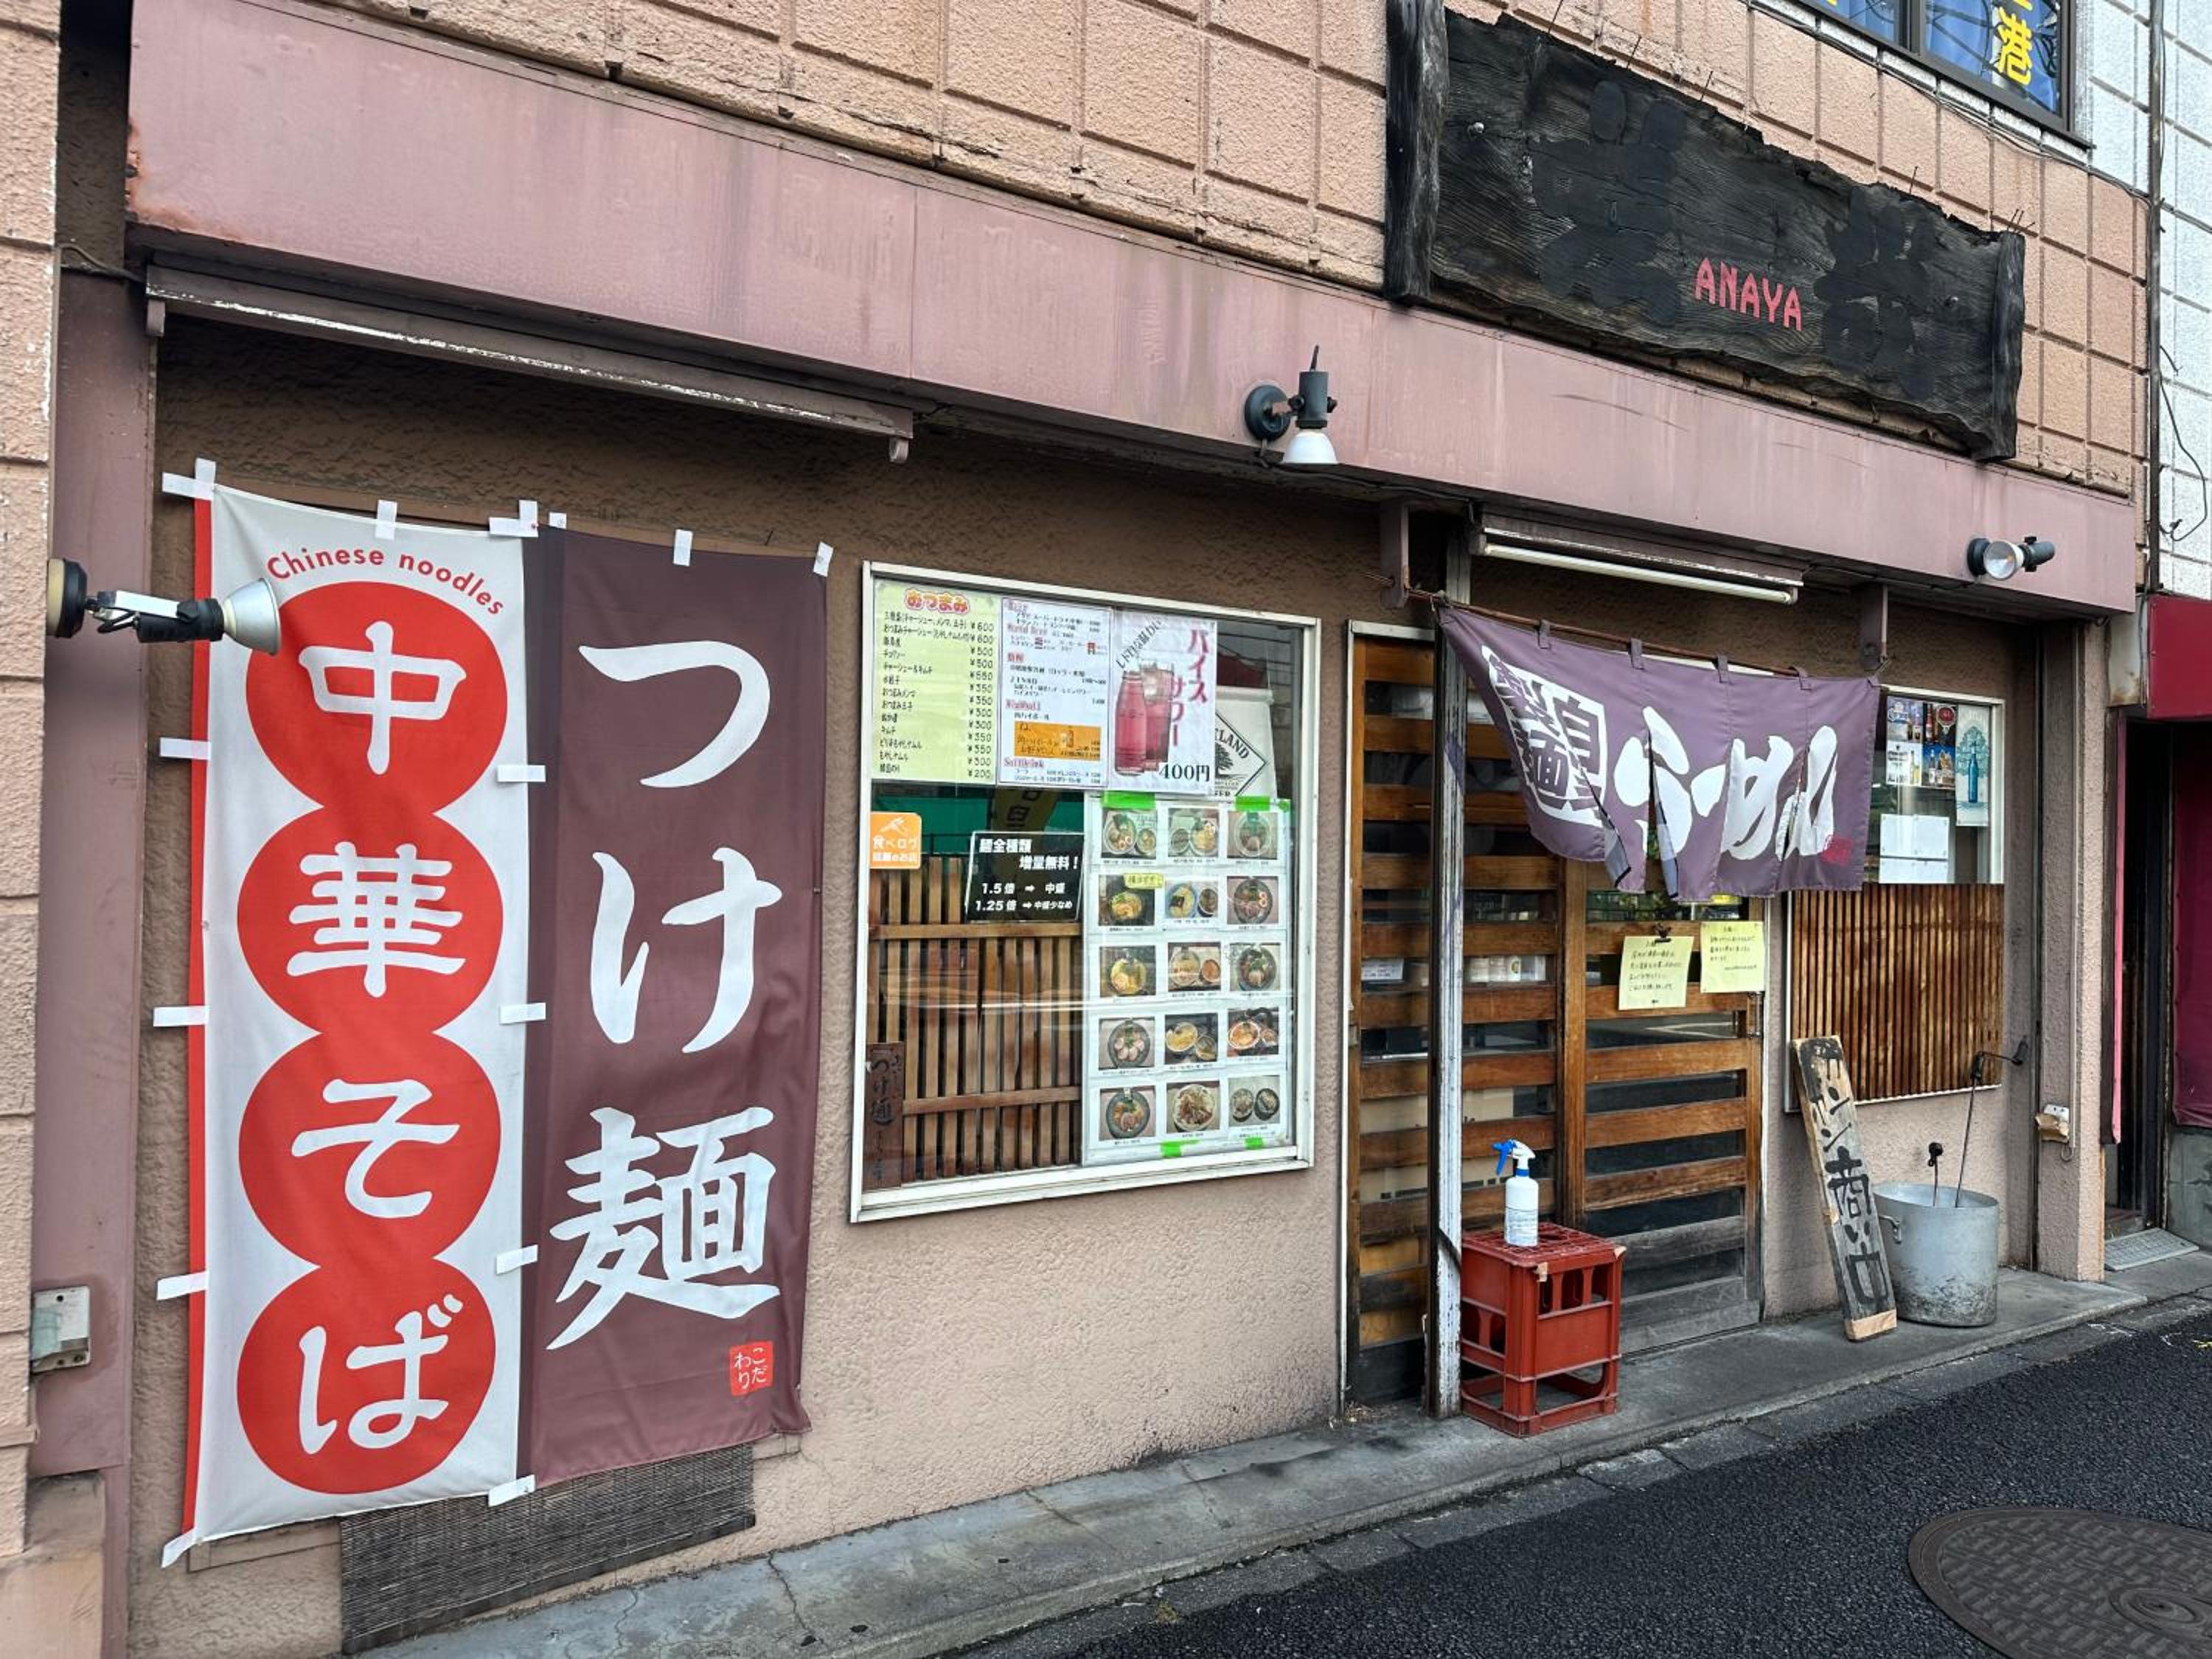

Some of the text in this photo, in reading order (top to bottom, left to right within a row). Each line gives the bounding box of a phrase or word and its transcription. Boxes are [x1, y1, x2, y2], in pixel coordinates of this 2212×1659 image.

[1997, 0, 2034, 86] 港
[1694, 257, 1803, 332] ANAYA
[267, 547, 504, 616] Chinese noodles
[905, 589, 969, 613] おつまみ
[1158, 764, 1210, 782] 400円
[546, 640, 782, 1351] つけ麺
[285, 619, 468, 1455] 中華そば
